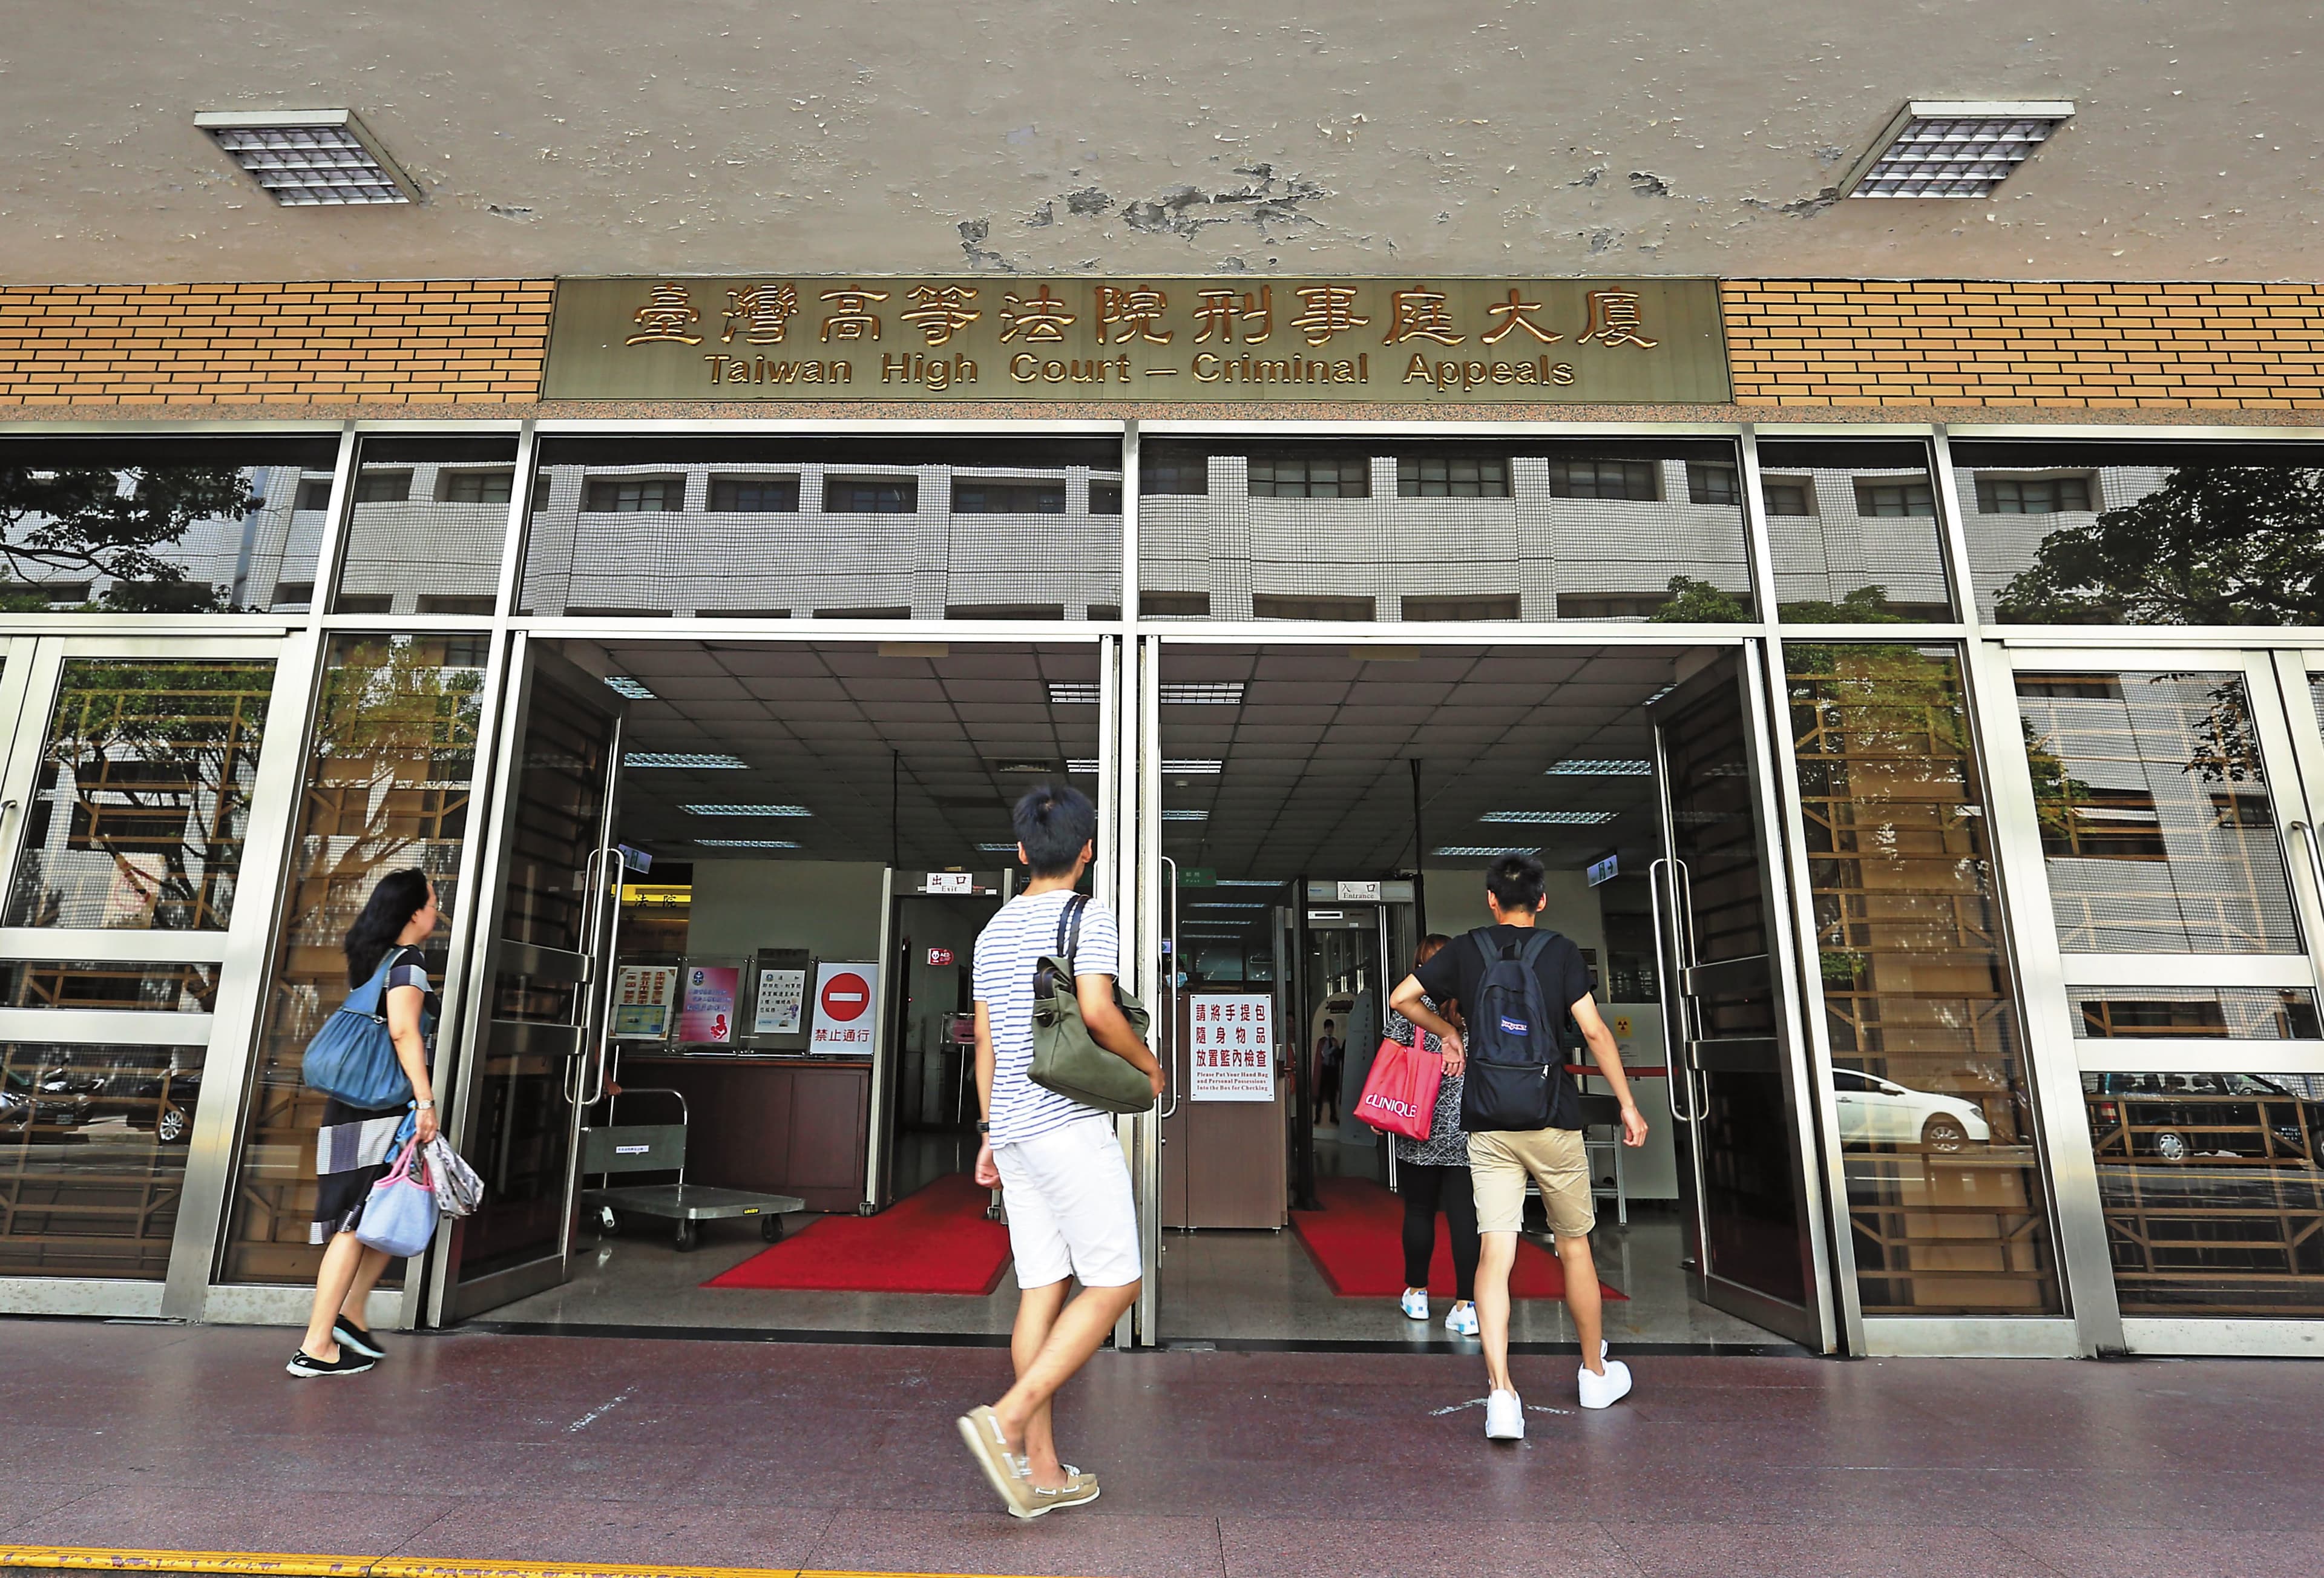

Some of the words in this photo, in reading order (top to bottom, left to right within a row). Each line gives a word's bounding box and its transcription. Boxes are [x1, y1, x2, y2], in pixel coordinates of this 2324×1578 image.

[625, 281, 1659, 349] 臺灣高等法院刑事庭大廈
[704, 353, 852, 385] Taiwan
[881, 352, 978, 392] High
[1009, 353, 1131, 384] Court
[1192, 352, 1369, 385] Criminal
[1402, 353, 1575, 393] Appeals
[932, 875, 967, 886] 出口
[1342, 883, 1376, 892] 入口
[1196, 1004, 1265, 1022] 請將手提包
[815, 1028, 870, 1042] 禁止通行
[1196, 1027, 1265, 1044] 隨身物品
[1196, 1049, 1267, 1067] 放置籃內檢查
[1365, 1094, 1417, 1117] CLINIQUE
